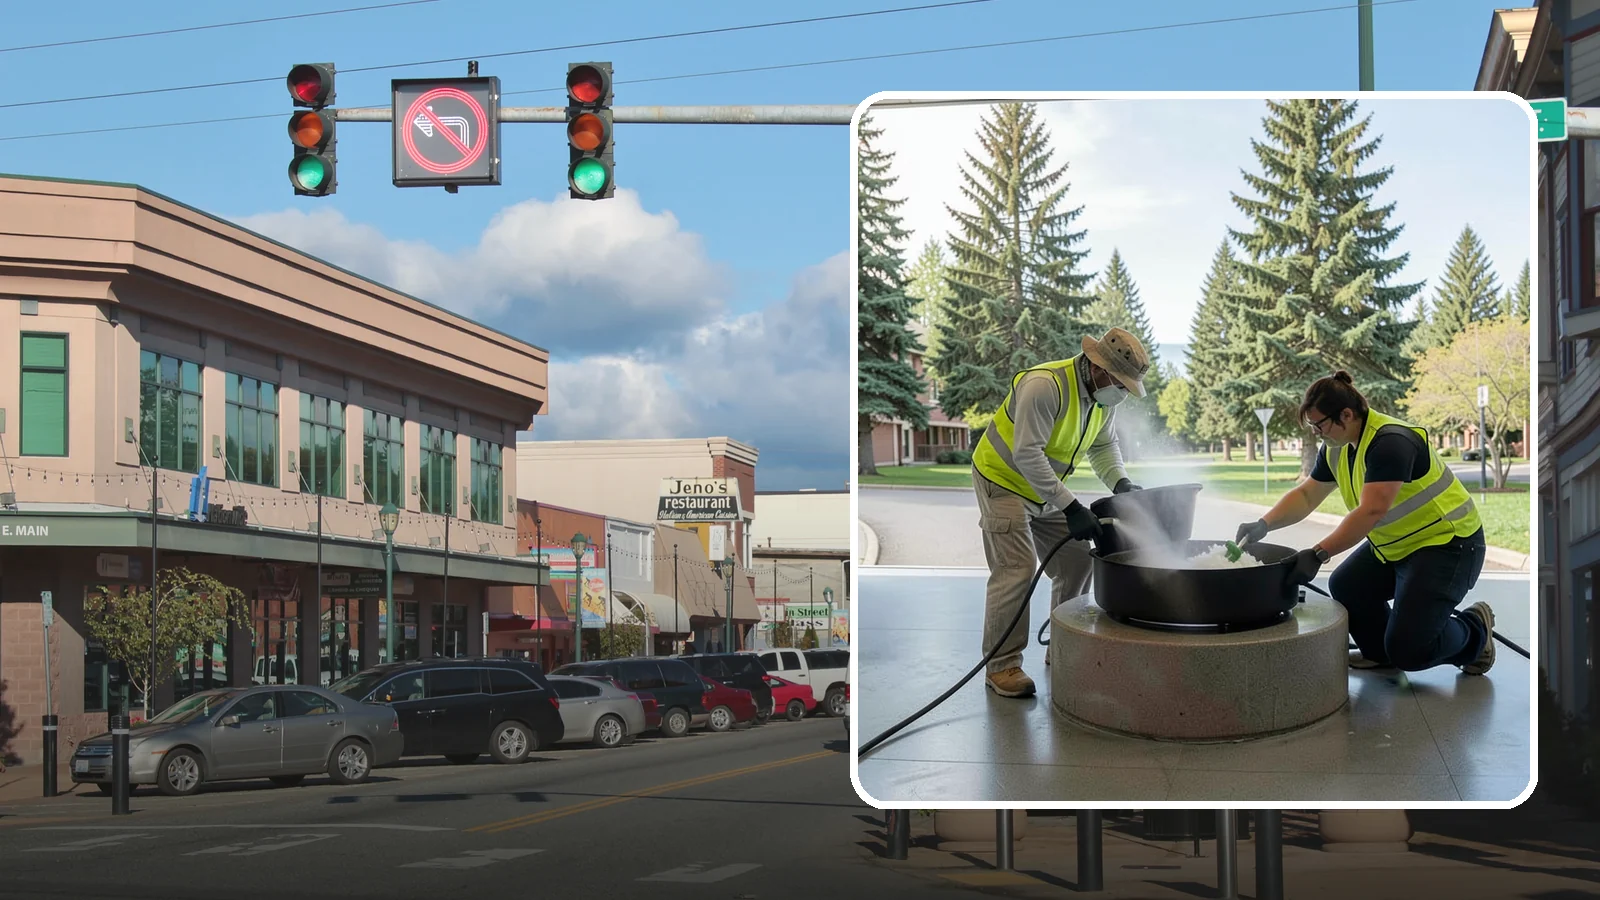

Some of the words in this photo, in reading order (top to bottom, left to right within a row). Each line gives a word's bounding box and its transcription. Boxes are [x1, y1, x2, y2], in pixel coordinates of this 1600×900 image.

[670, 480, 727, 495] Jeno's
[665, 496, 731, 509] restaurant
[658, 509, 682, 520] Italian
[686, 509, 714, 520] American
[715, 509, 738, 520] Cuisine
[2, 525, 13, 536] E.
[15, 525, 49, 536] MAIN
[797, 607, 828, 617] Street
